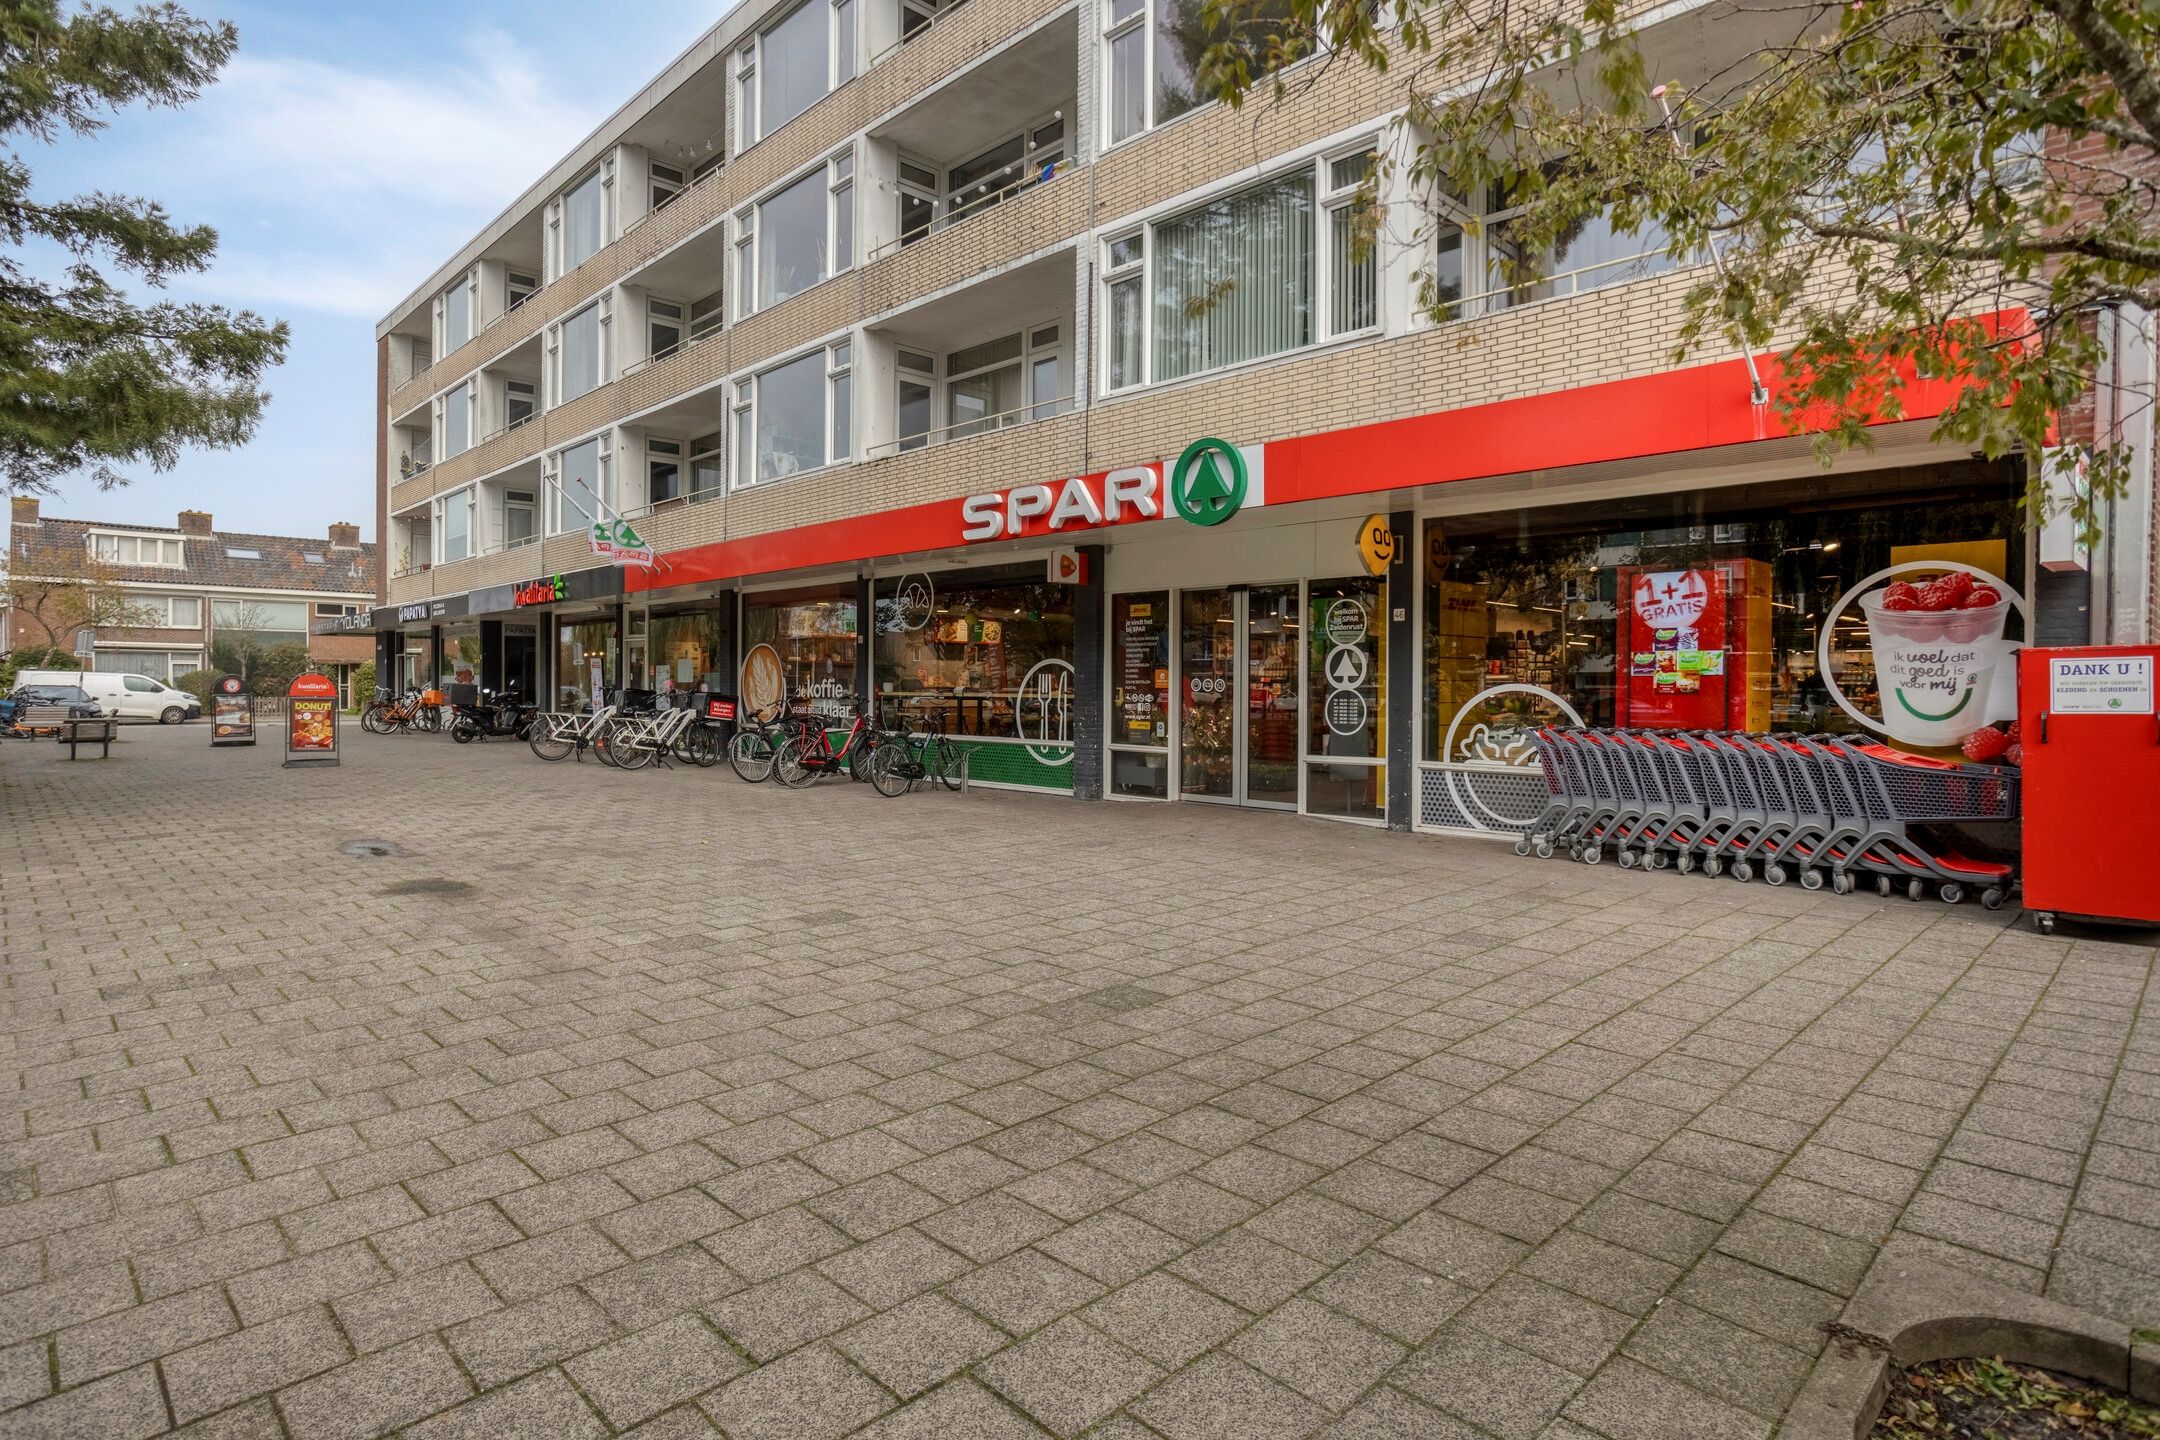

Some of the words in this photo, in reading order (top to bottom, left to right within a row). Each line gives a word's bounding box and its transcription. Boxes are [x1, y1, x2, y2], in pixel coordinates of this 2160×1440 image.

[963, 467, 1157, 540] SPAR
[514, 581, 555, 607] kwalitaria
[1635, 570, 1704, 607] 1+1
[1342, 615, 1359, 623] SPAR
[1395, 610, 1404, 618] 46
[1642, 600, 1704, 621] GRATIS
[340, 613, 371, 630] YOLANDA
[1893, 651, 1904, 662] ik
[1907, 649, 1949, 663] voel
[1951, 652, 1976, 663] dat
[1890, 665, 1906, 675] dit
[1908, 664, 1950, 682] goed
[1953, 666, 1965, 675] is
[2060, 664, 2110, 676] DANK
[2117, 663, 2130, 675] U
[807, 678, 843, 698] koffie
[1900, 680, 1926, 689] voor
[1929, 677, 1957, 695] mij
[295, 702, 333, 711] DONUT!
[823, 700, 851, 718] klaar
